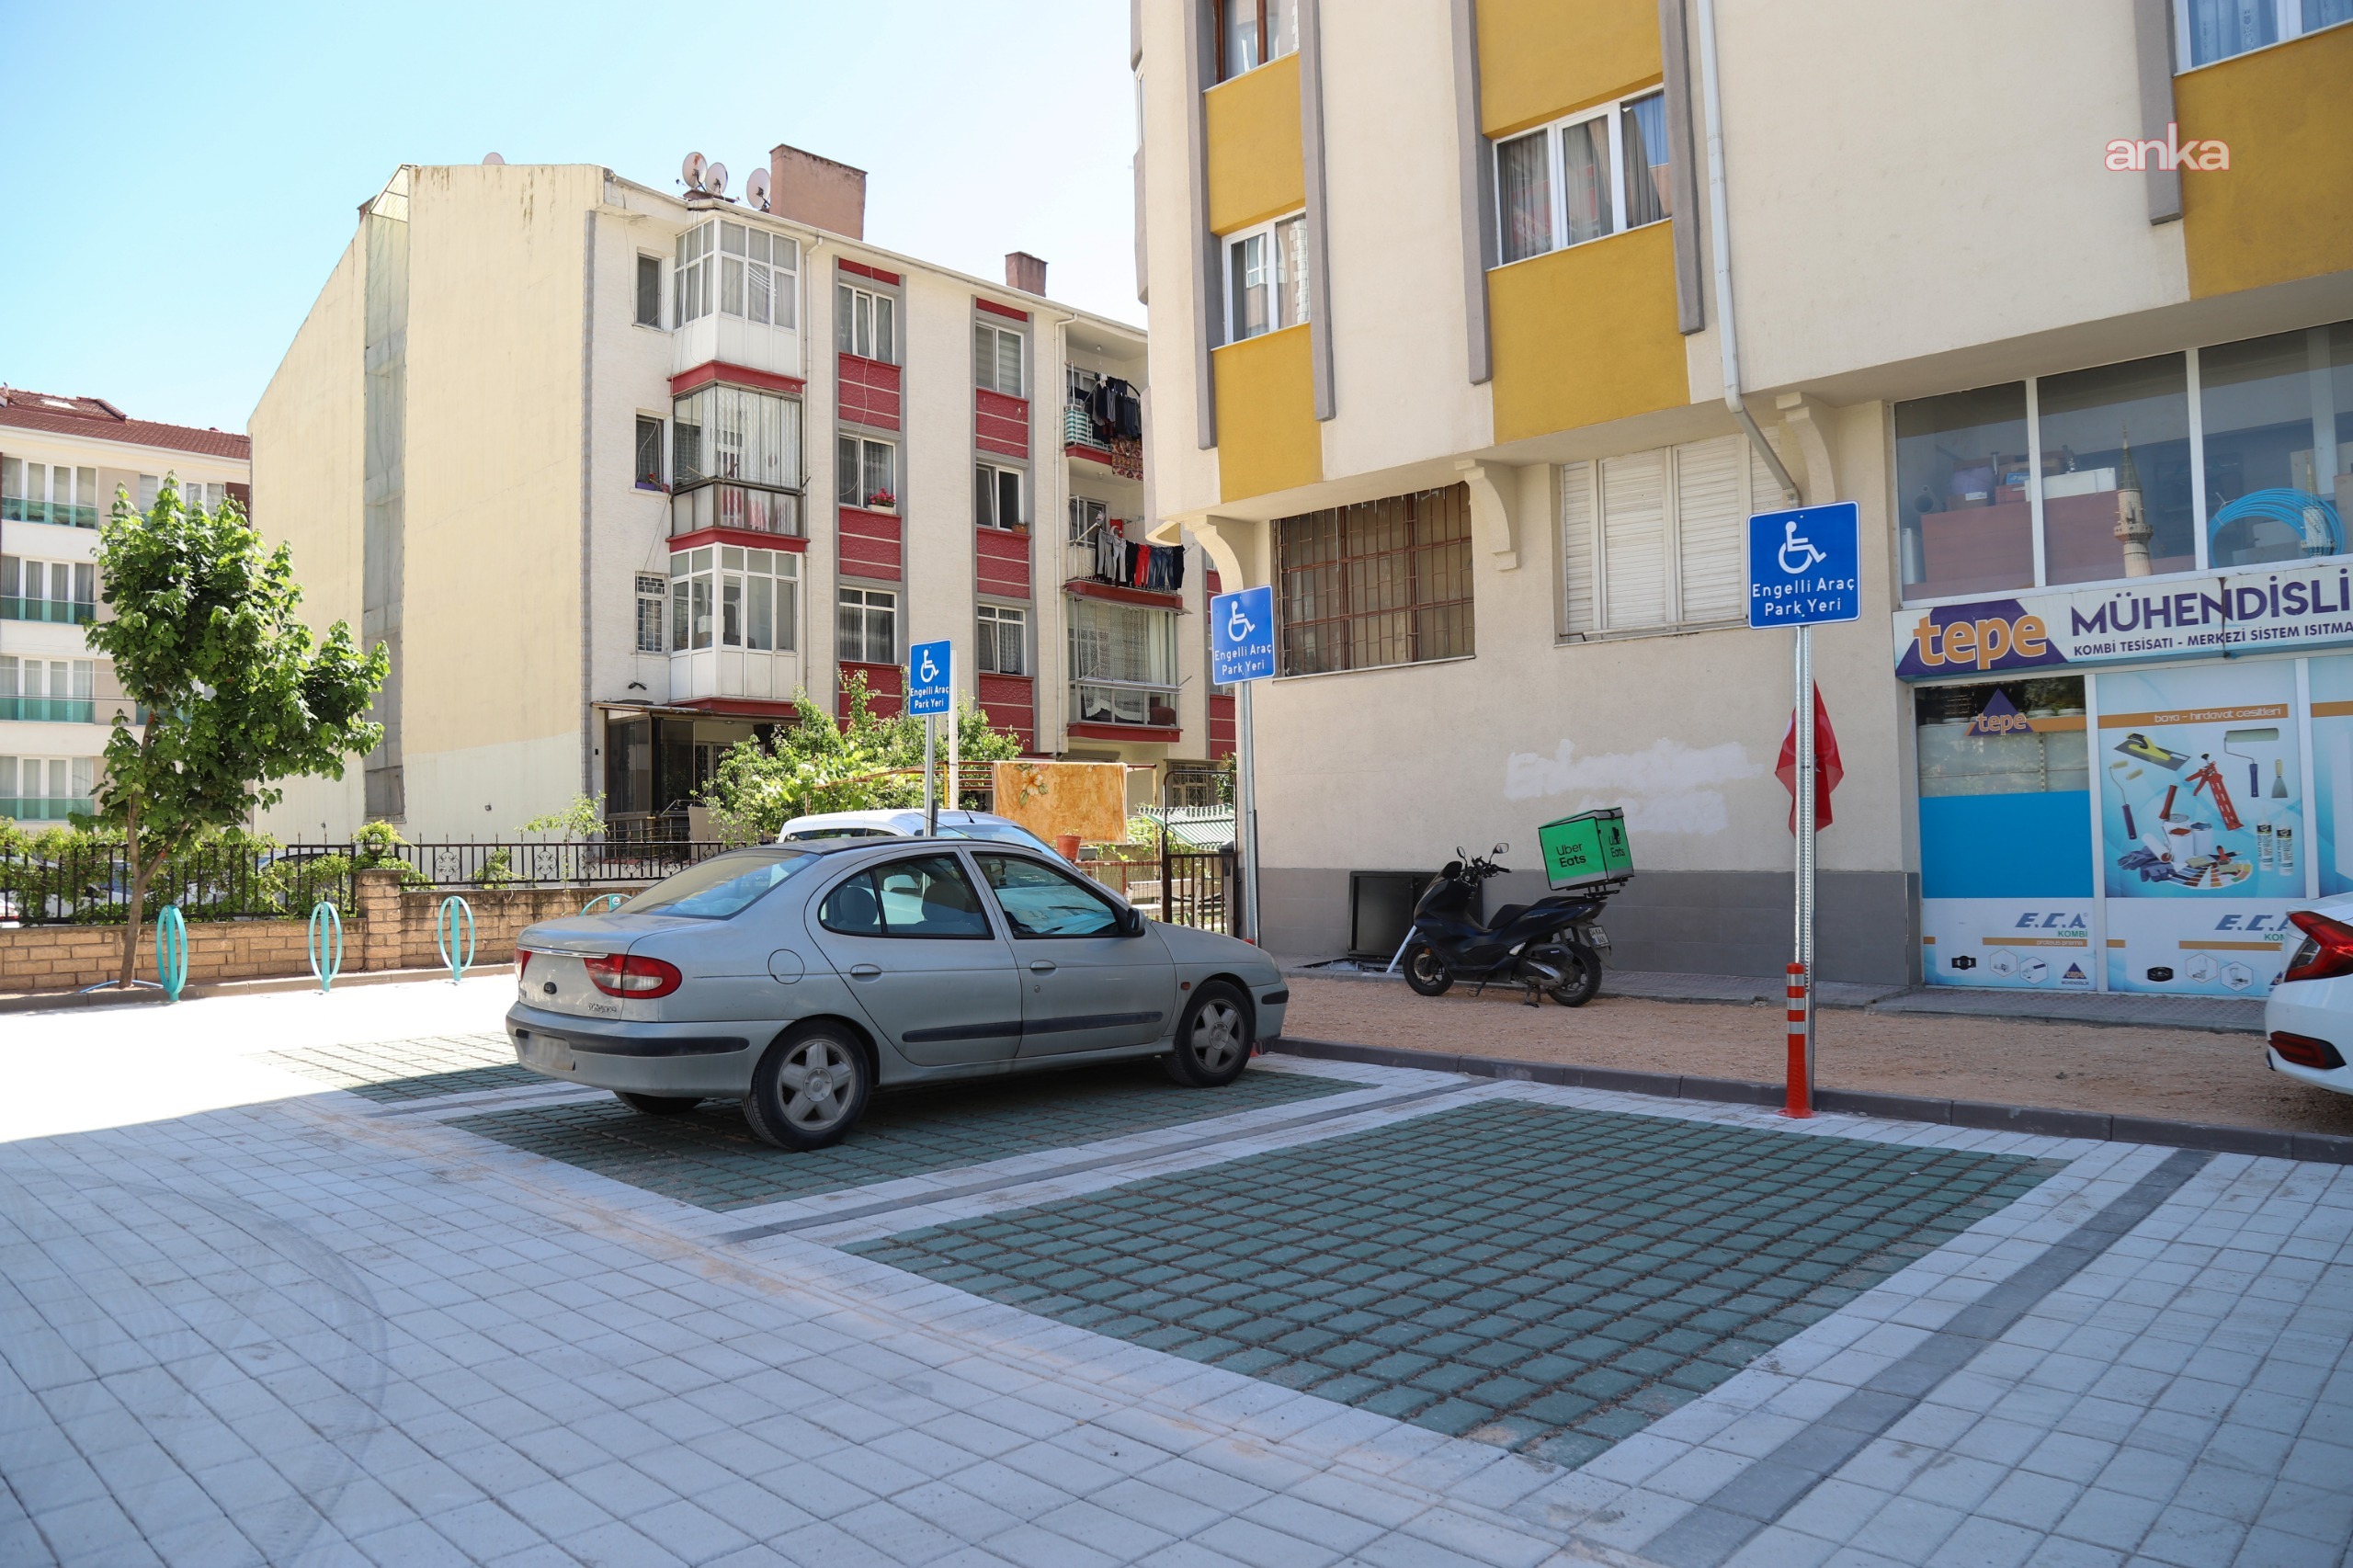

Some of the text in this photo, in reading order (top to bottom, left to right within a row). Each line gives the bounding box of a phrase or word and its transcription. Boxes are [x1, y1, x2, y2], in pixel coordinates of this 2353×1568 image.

[1752, 577, 1855, 599] Engelli Araç
[1765, 597, 1841, 617] Park Yeri
[1913, 568, 2350, 670] tepe MÜHENDİSLİ
[2074, 640, 2116, 656] KOMBİ
[2120, 636, 2173, 652] TESİSATI
[2188, 628, 2245, 646] MERKEZİ
[2250, 626, 2300, 641] SİSTEM
[2304, 621, 2353, 636] ISITMA
[1214, 643, 1272, 662] Engelli Araç
[1222, 659, 1265, 676] Park Yeri
[910, 685, 949, 698] Engelli Araç
[915, 698, 944, 709] Park Yeri
[1976, 712, 2027, 735] tepe
[2154, 714, 2180, 723] boya
[1556, 843, 1583, 856] Uber
[1610, 846, 1625, 858] Eats
[1559, 855, 1586, 868] Eats
[2058, 928, 2088, 937] KOMBİ
